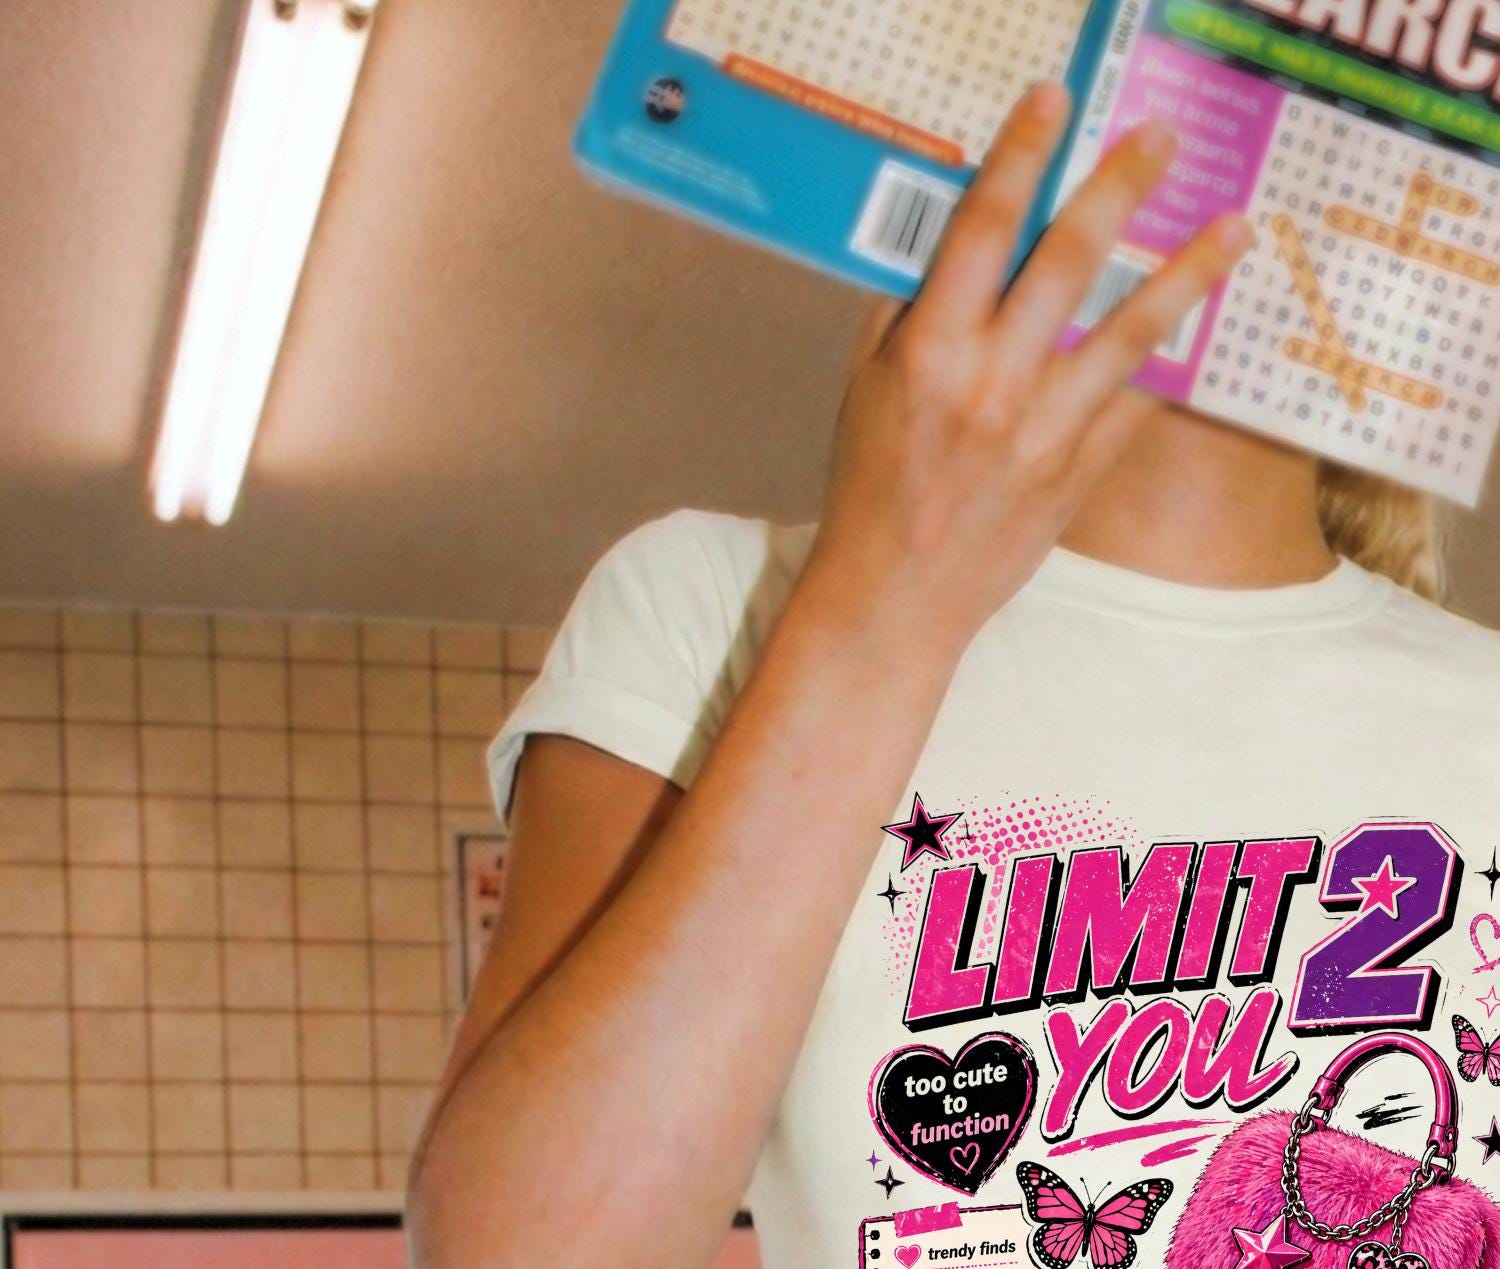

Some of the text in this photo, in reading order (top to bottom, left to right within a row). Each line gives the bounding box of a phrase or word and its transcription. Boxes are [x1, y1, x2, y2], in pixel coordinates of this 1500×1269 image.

[902, 821, 1465, 1037] LIMIT 2
[1040, 984, 1300, 1140] YOU
[904, 1062, 1008, 1098] too cute
[942, 1094, 968, 1115] to
[910, 1112, 1010, 1146] function
[928, 1239, 1016, 1260] trendy finds
